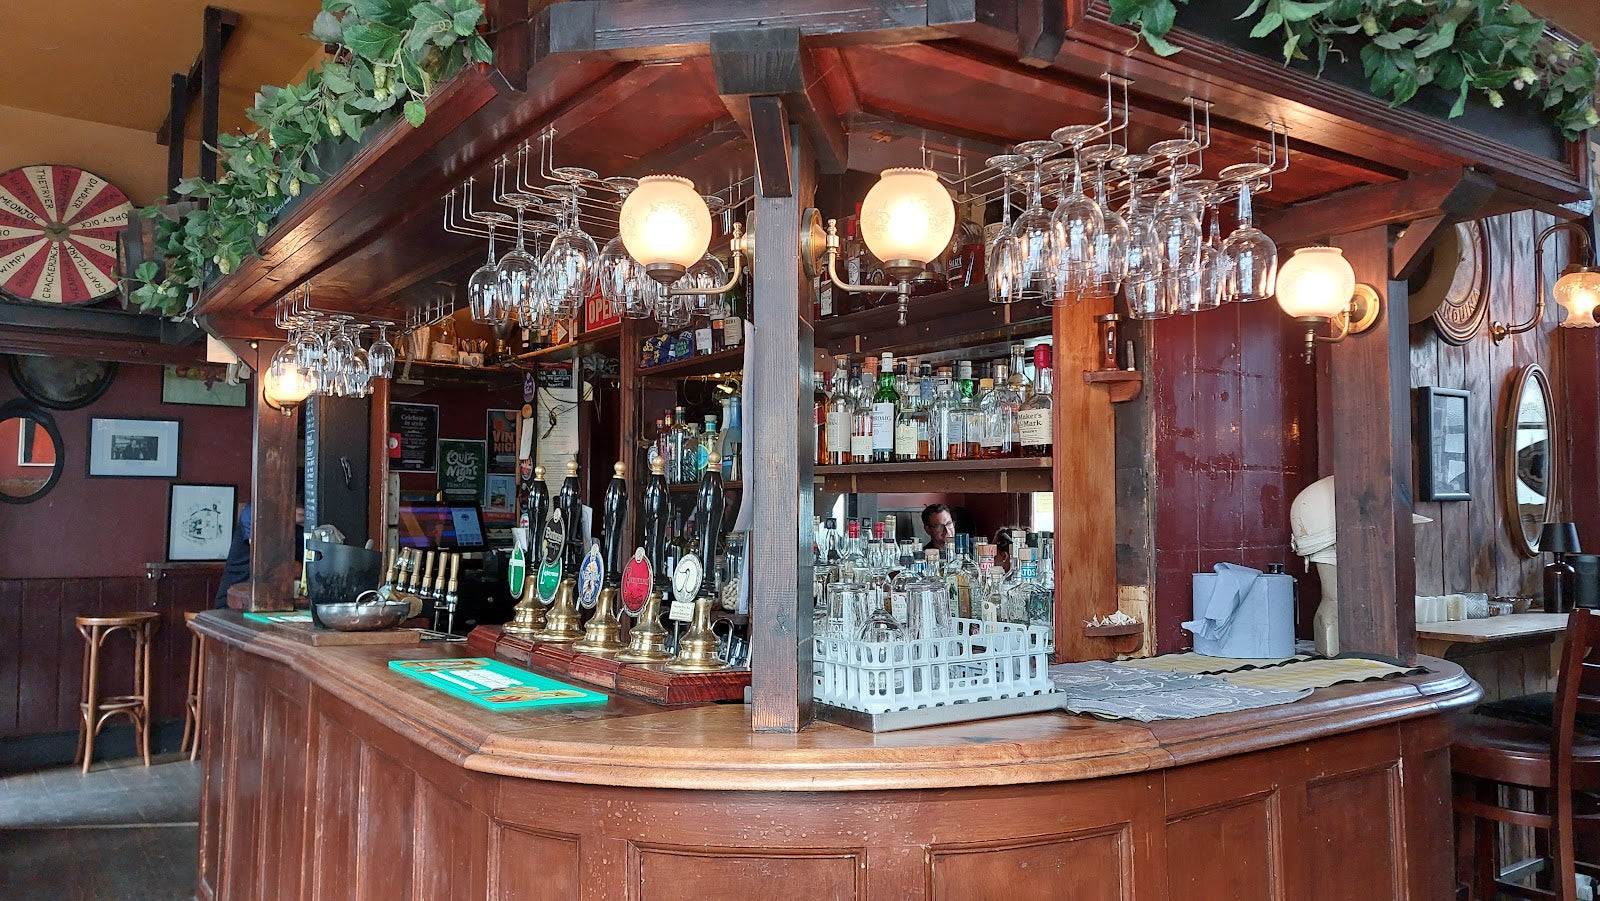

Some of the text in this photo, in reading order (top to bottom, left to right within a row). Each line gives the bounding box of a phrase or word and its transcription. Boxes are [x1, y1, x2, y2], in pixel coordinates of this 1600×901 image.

[72, 177, 98, 209] DAWDLER
[103, 211, 128, 224] OPEY
[100, 242, 117, 253] AGO
[492, 430, 516, 443] VIN
[1021, 568, 1036, 577] LTOS
